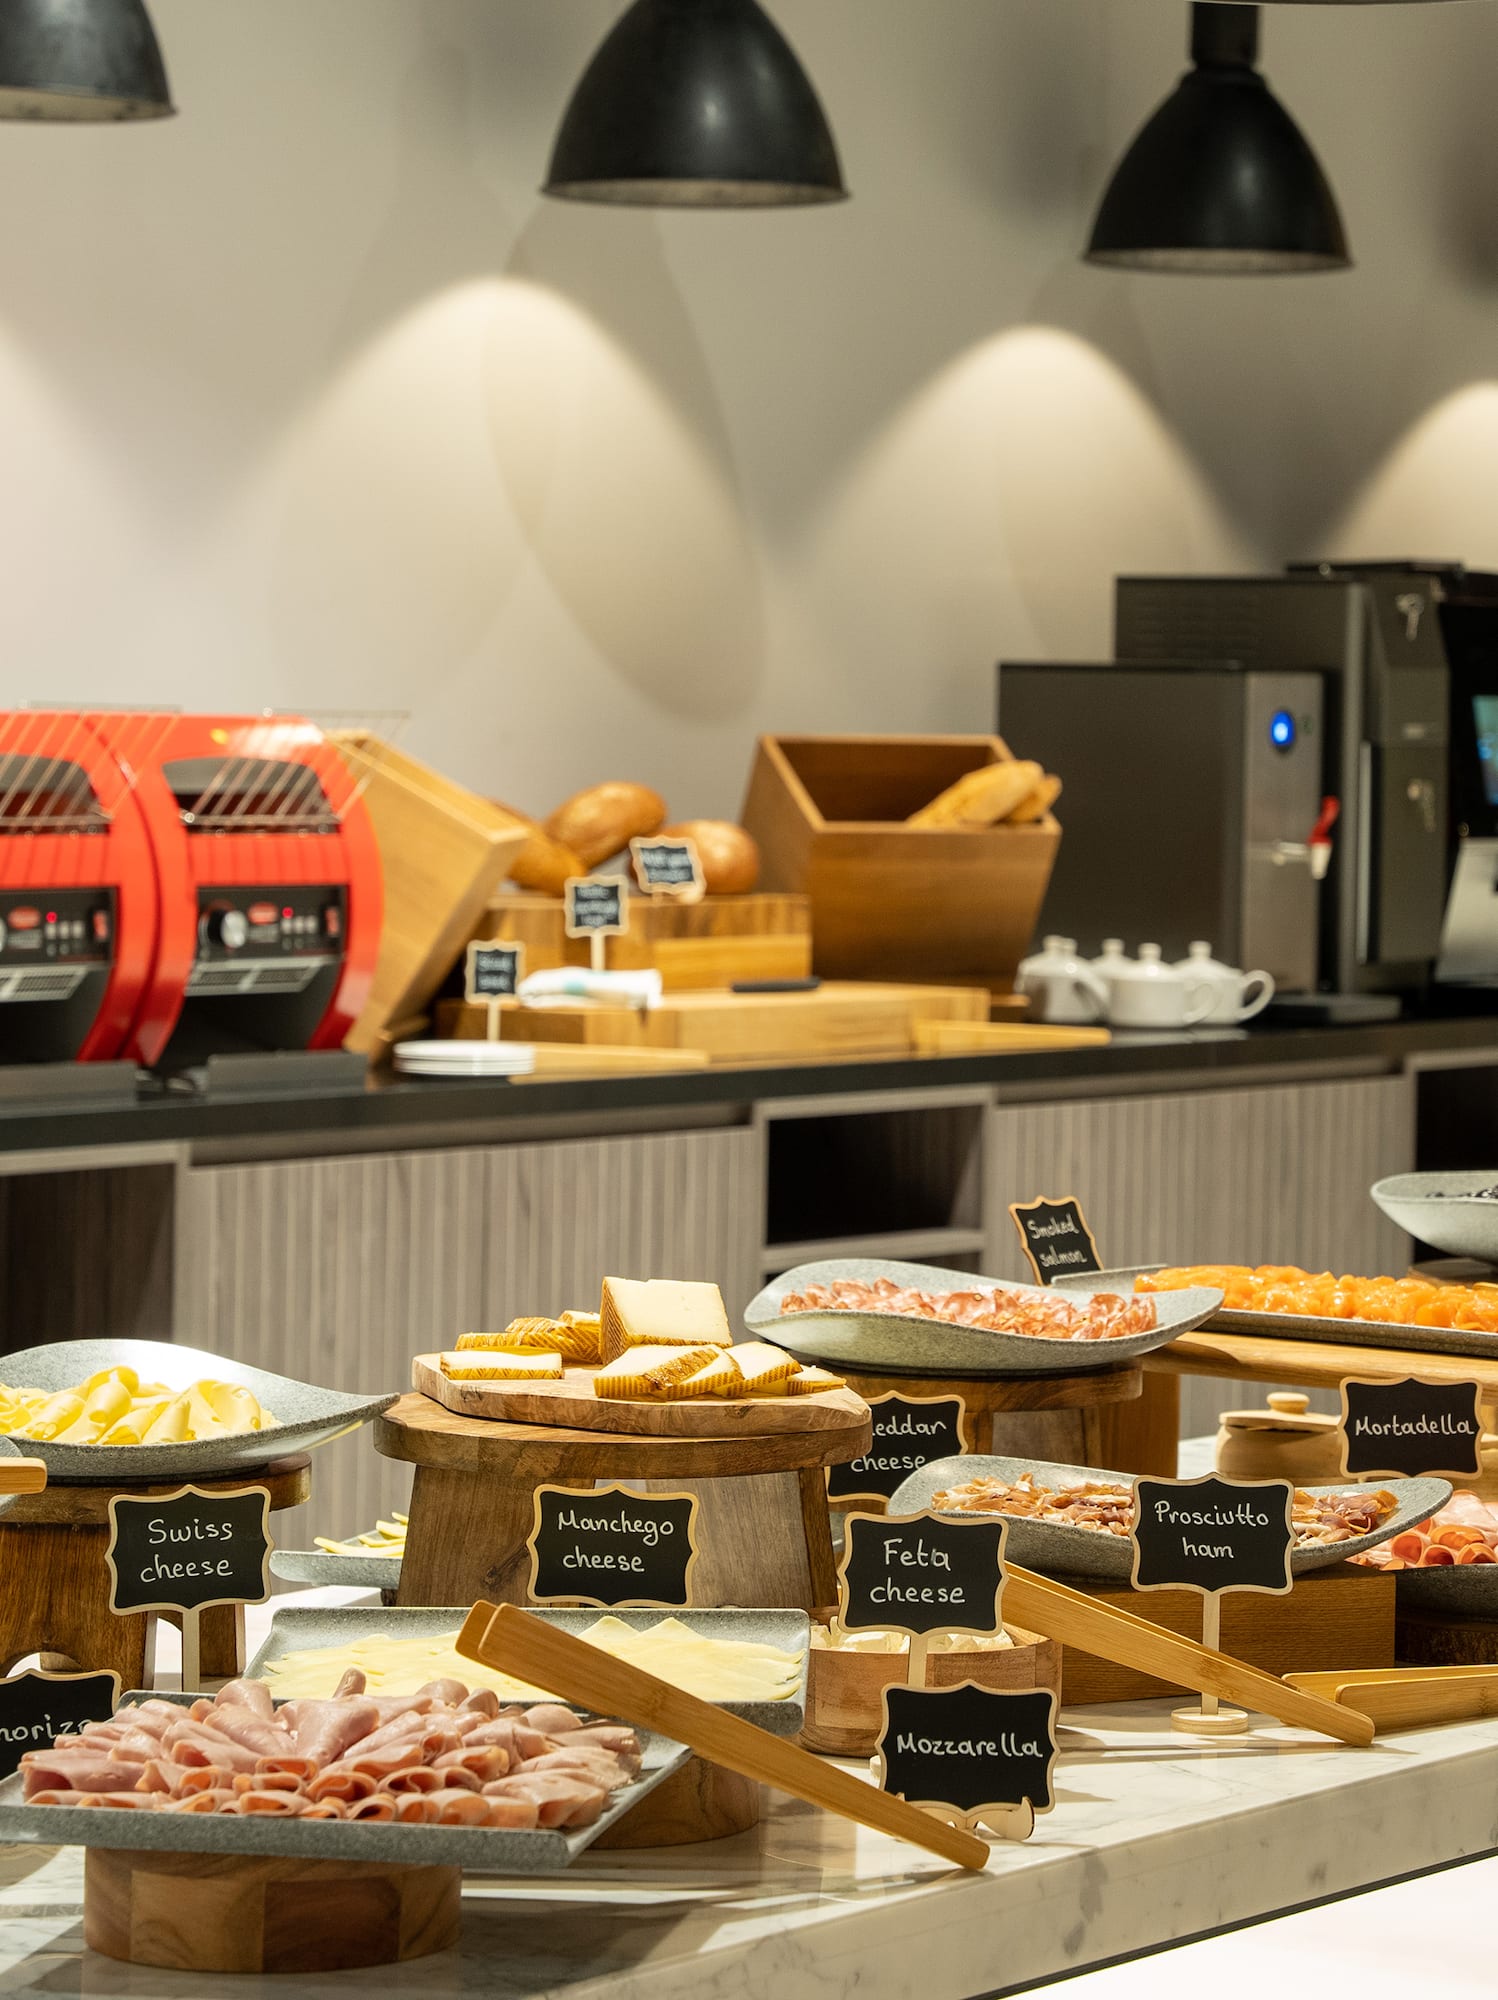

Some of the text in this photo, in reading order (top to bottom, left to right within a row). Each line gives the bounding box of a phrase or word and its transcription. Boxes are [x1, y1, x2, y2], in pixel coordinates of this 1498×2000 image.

[1026, 1212, 1080, 1240] Smoked
[1038, 1244, 1088, 1268] salmon
[871, 1413, 947, 1437] eddar
[1354, 1415, 1475, 1437] Mortadella
[850, 1454, 926, 1473] cheese
[1154, 1499, 1270, 1528] Prosciutto
[147, 1517, 234, 1545] Swiss
[556, 1509, 675, 1547] Manchego
[561, 1545, 646, 1573] cheese
[882, 1538, 952, 1570] Feta
[1182, 1537, 1235, 1560] ham
[139, 1553, 234, 1584] cheese
[868, 1576, 967, 1605] cheese
[896, 1732, 1044, 1758] Mozzarella
